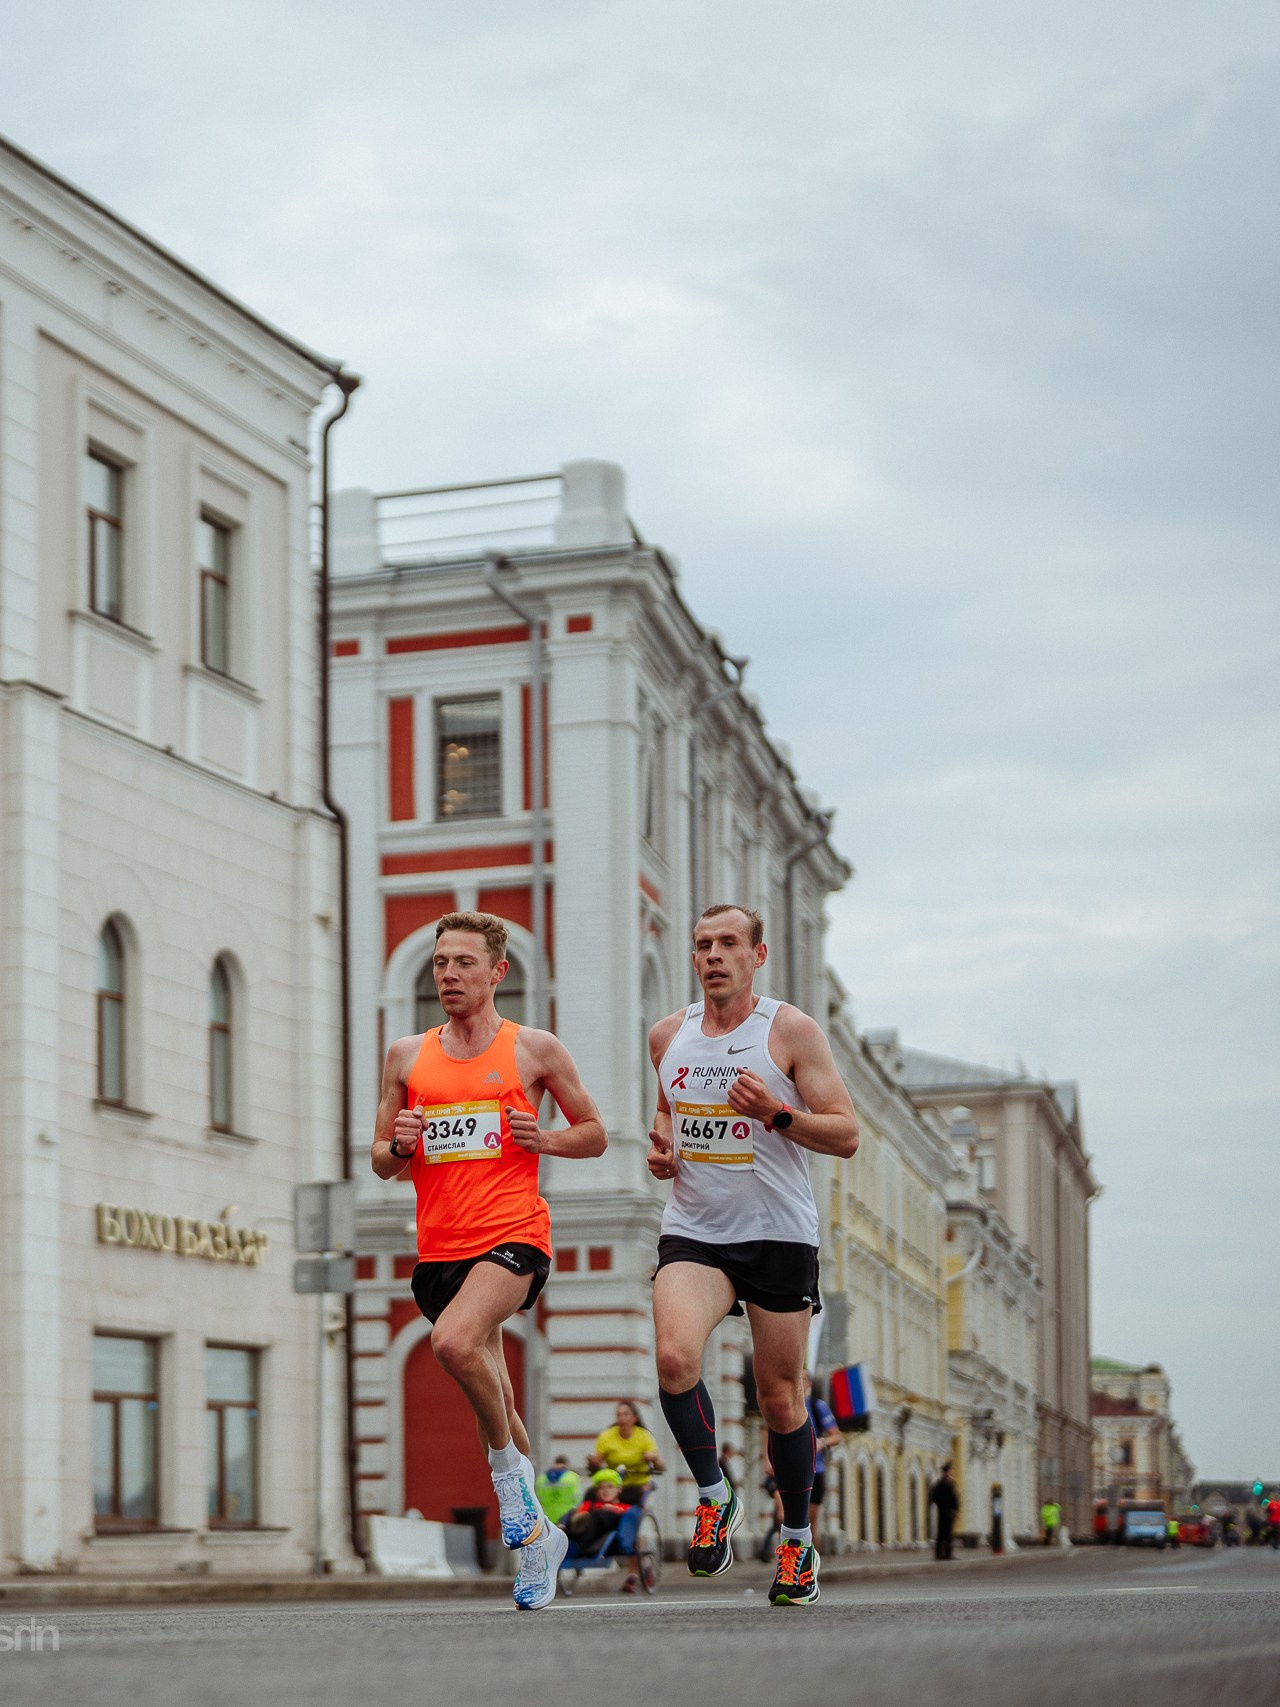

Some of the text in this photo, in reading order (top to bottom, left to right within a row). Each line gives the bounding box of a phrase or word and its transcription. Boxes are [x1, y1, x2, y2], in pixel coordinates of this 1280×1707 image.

[692, 1066, 749, 1078] RUNNIN
[427, 1117, 477, 1141] 3349
[680, 1118, 728, 1140] 4667
[427, 1141, 466, 1152] СТАНИСЛАВ
[681, 1140, 710, 1151] ДМИТРИЙ
